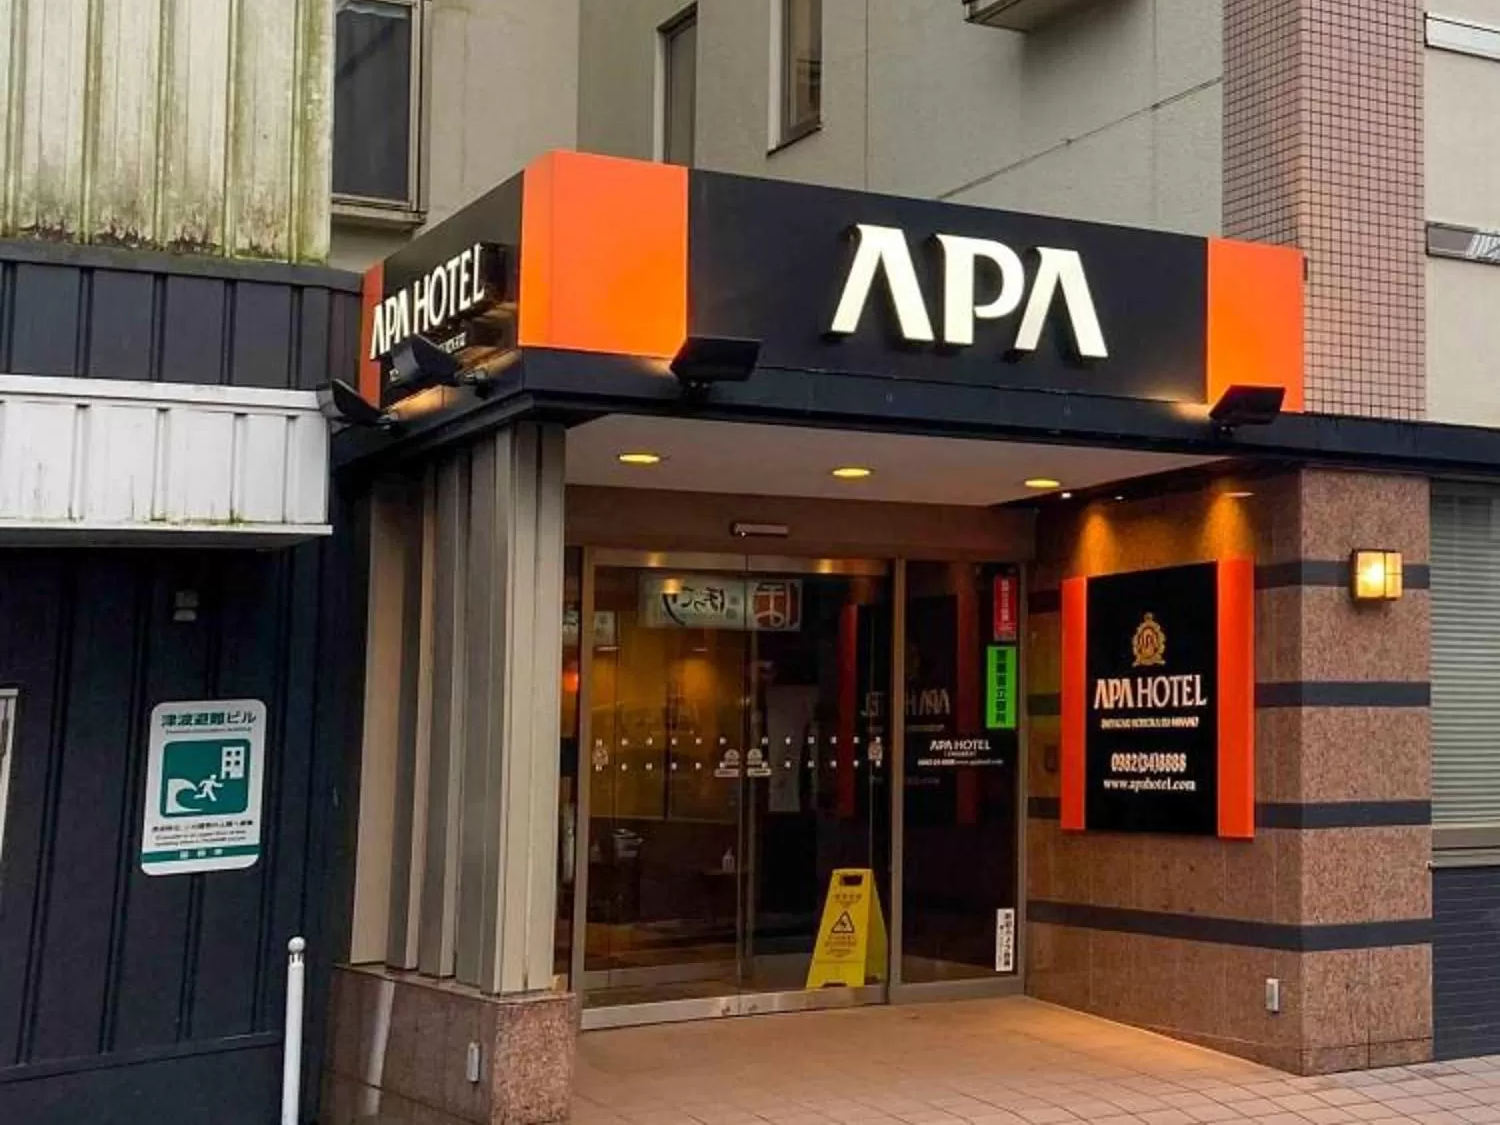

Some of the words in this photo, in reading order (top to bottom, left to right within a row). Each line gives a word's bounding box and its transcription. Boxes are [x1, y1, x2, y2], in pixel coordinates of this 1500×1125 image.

[370, 288, 410, 360] APA
[413, 242, 485, 335] HOTEL
[831, 223, 1109, 358] APA
[1094, 677, 1135, 710] APA
[1137, 673, 1208, 709] HOTEL
[1103, 777, 1197, 794] www.apahotel.com
